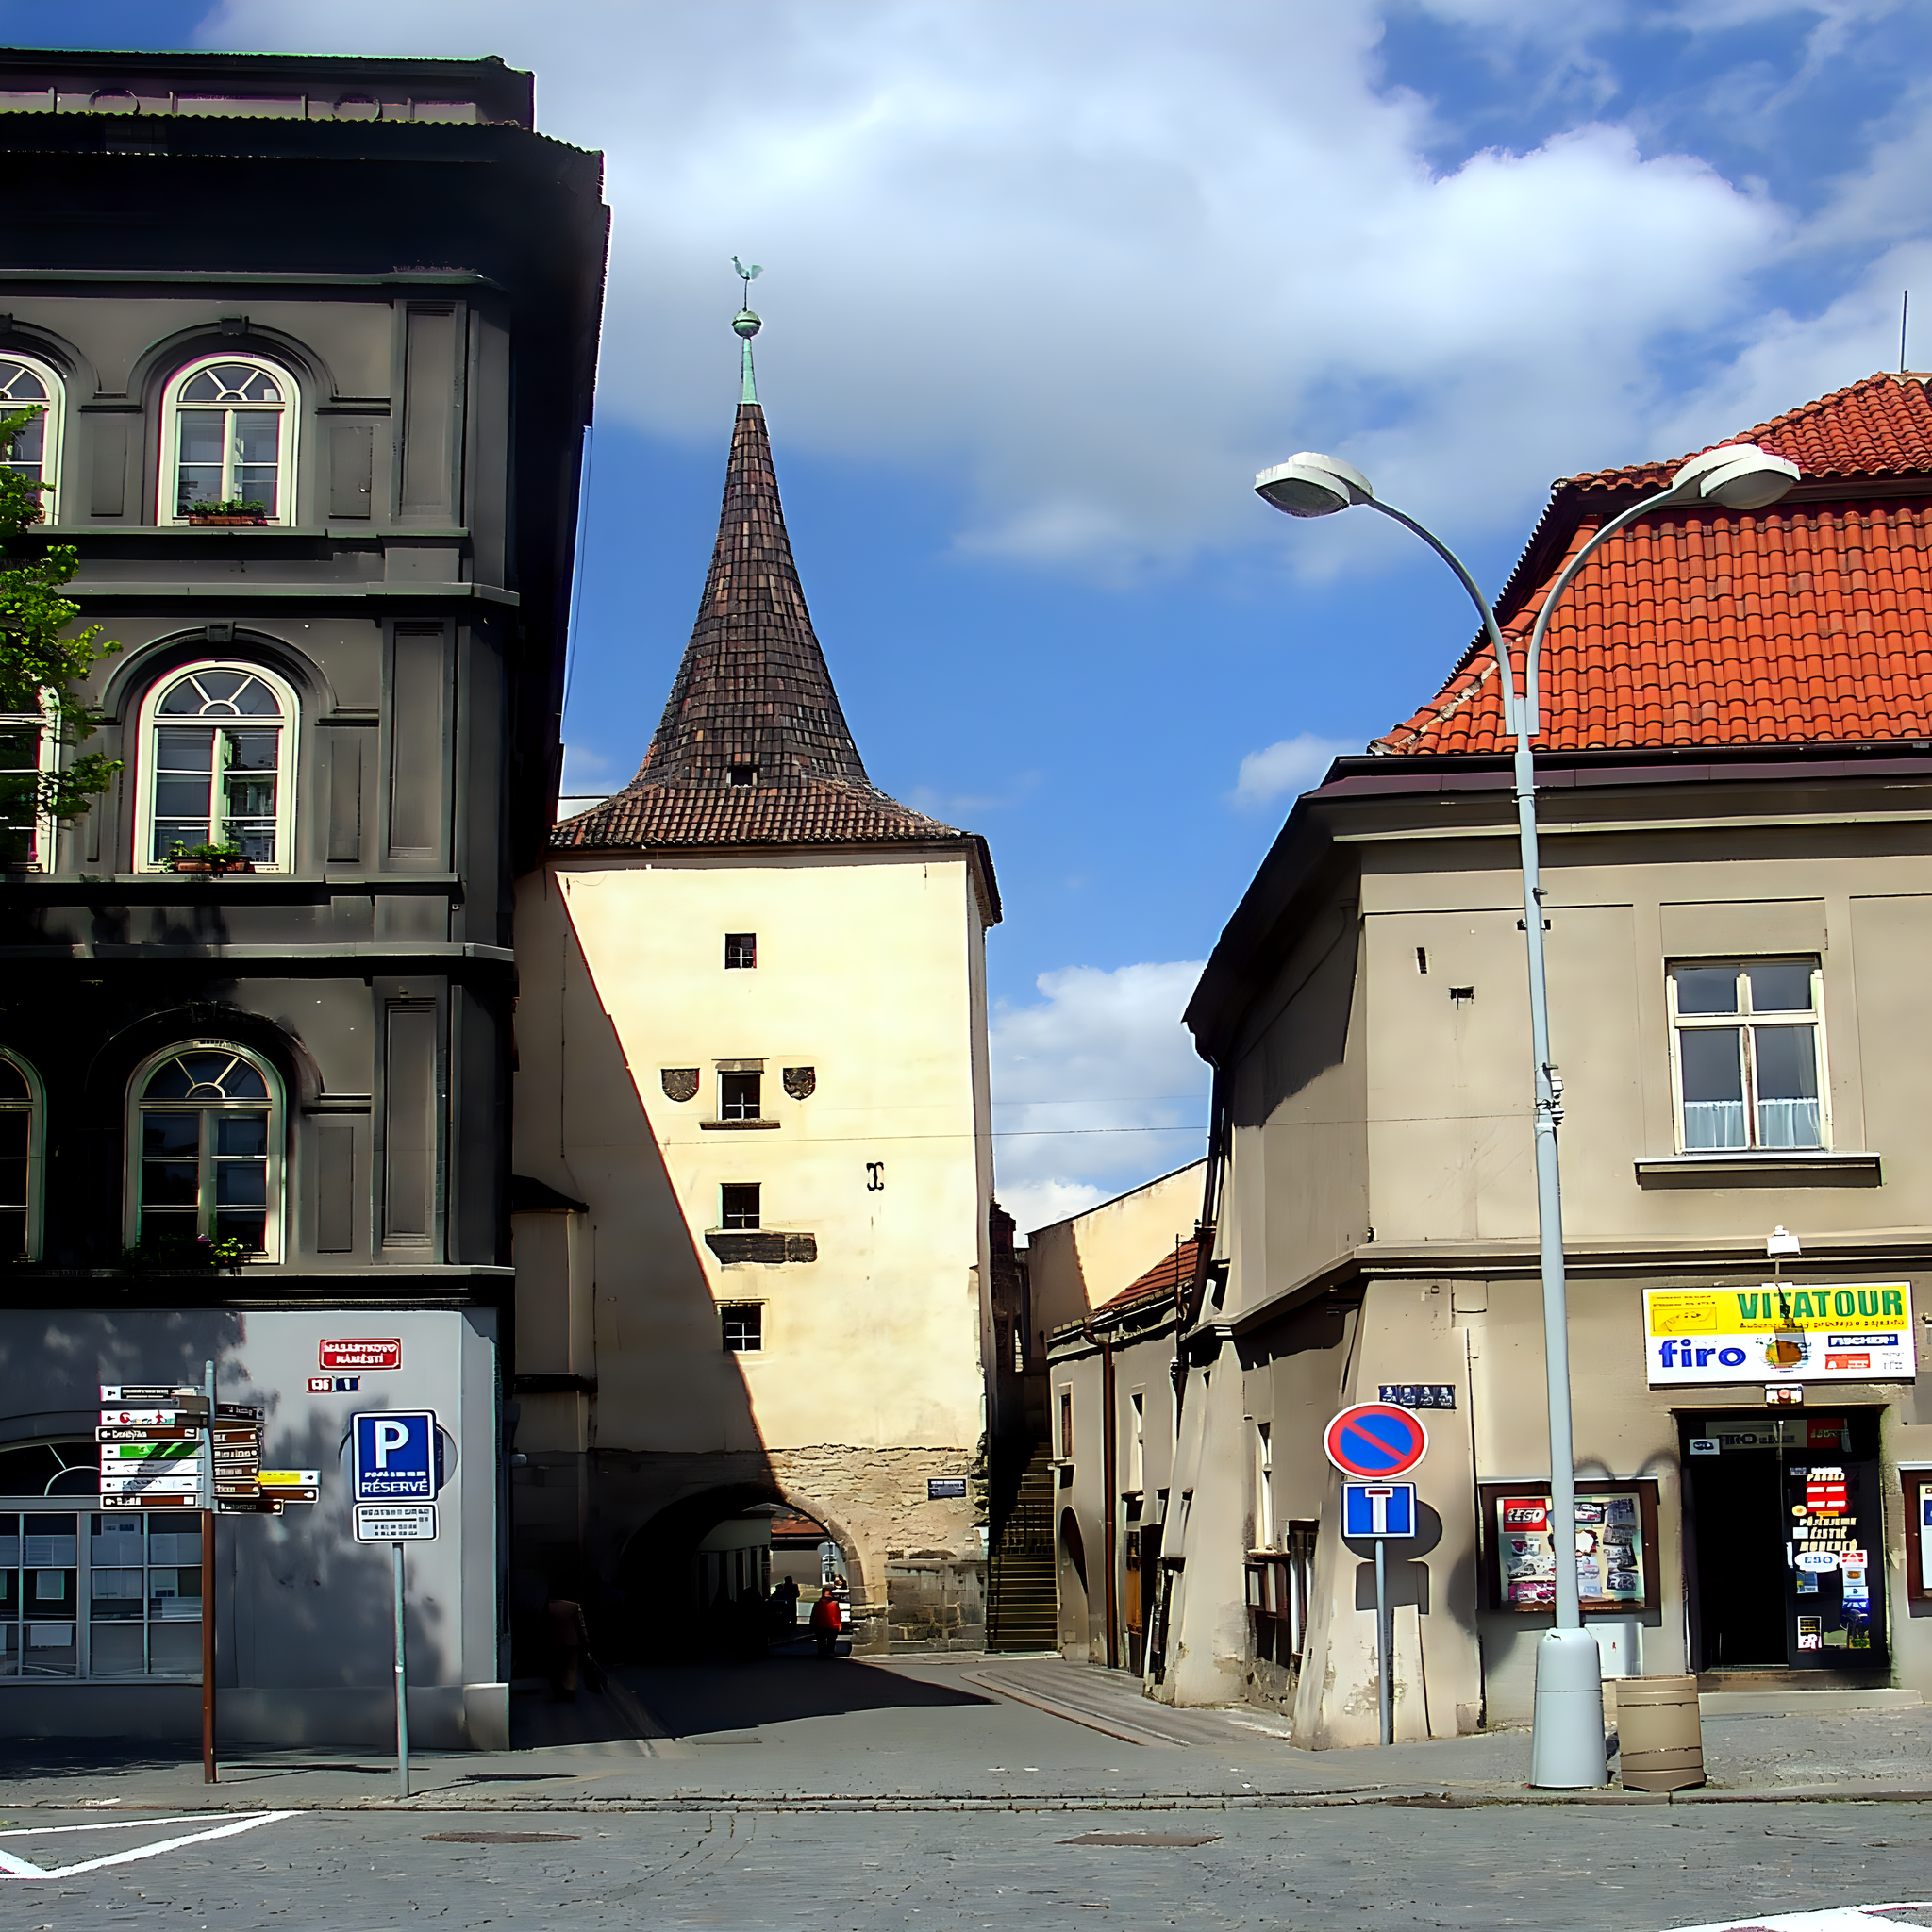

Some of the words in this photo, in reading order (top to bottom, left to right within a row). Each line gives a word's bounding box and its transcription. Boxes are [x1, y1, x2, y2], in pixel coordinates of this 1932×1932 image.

[1737, 1290, 1903, 1319] VITATOUR
[1658, 1338, 1746, 1368] firo
[375, 1420, 409, 1469] P
[361, 1479, 428, 1493] RÉSERVÉ
[1507, 1507, 1545, 1523] LEGO
